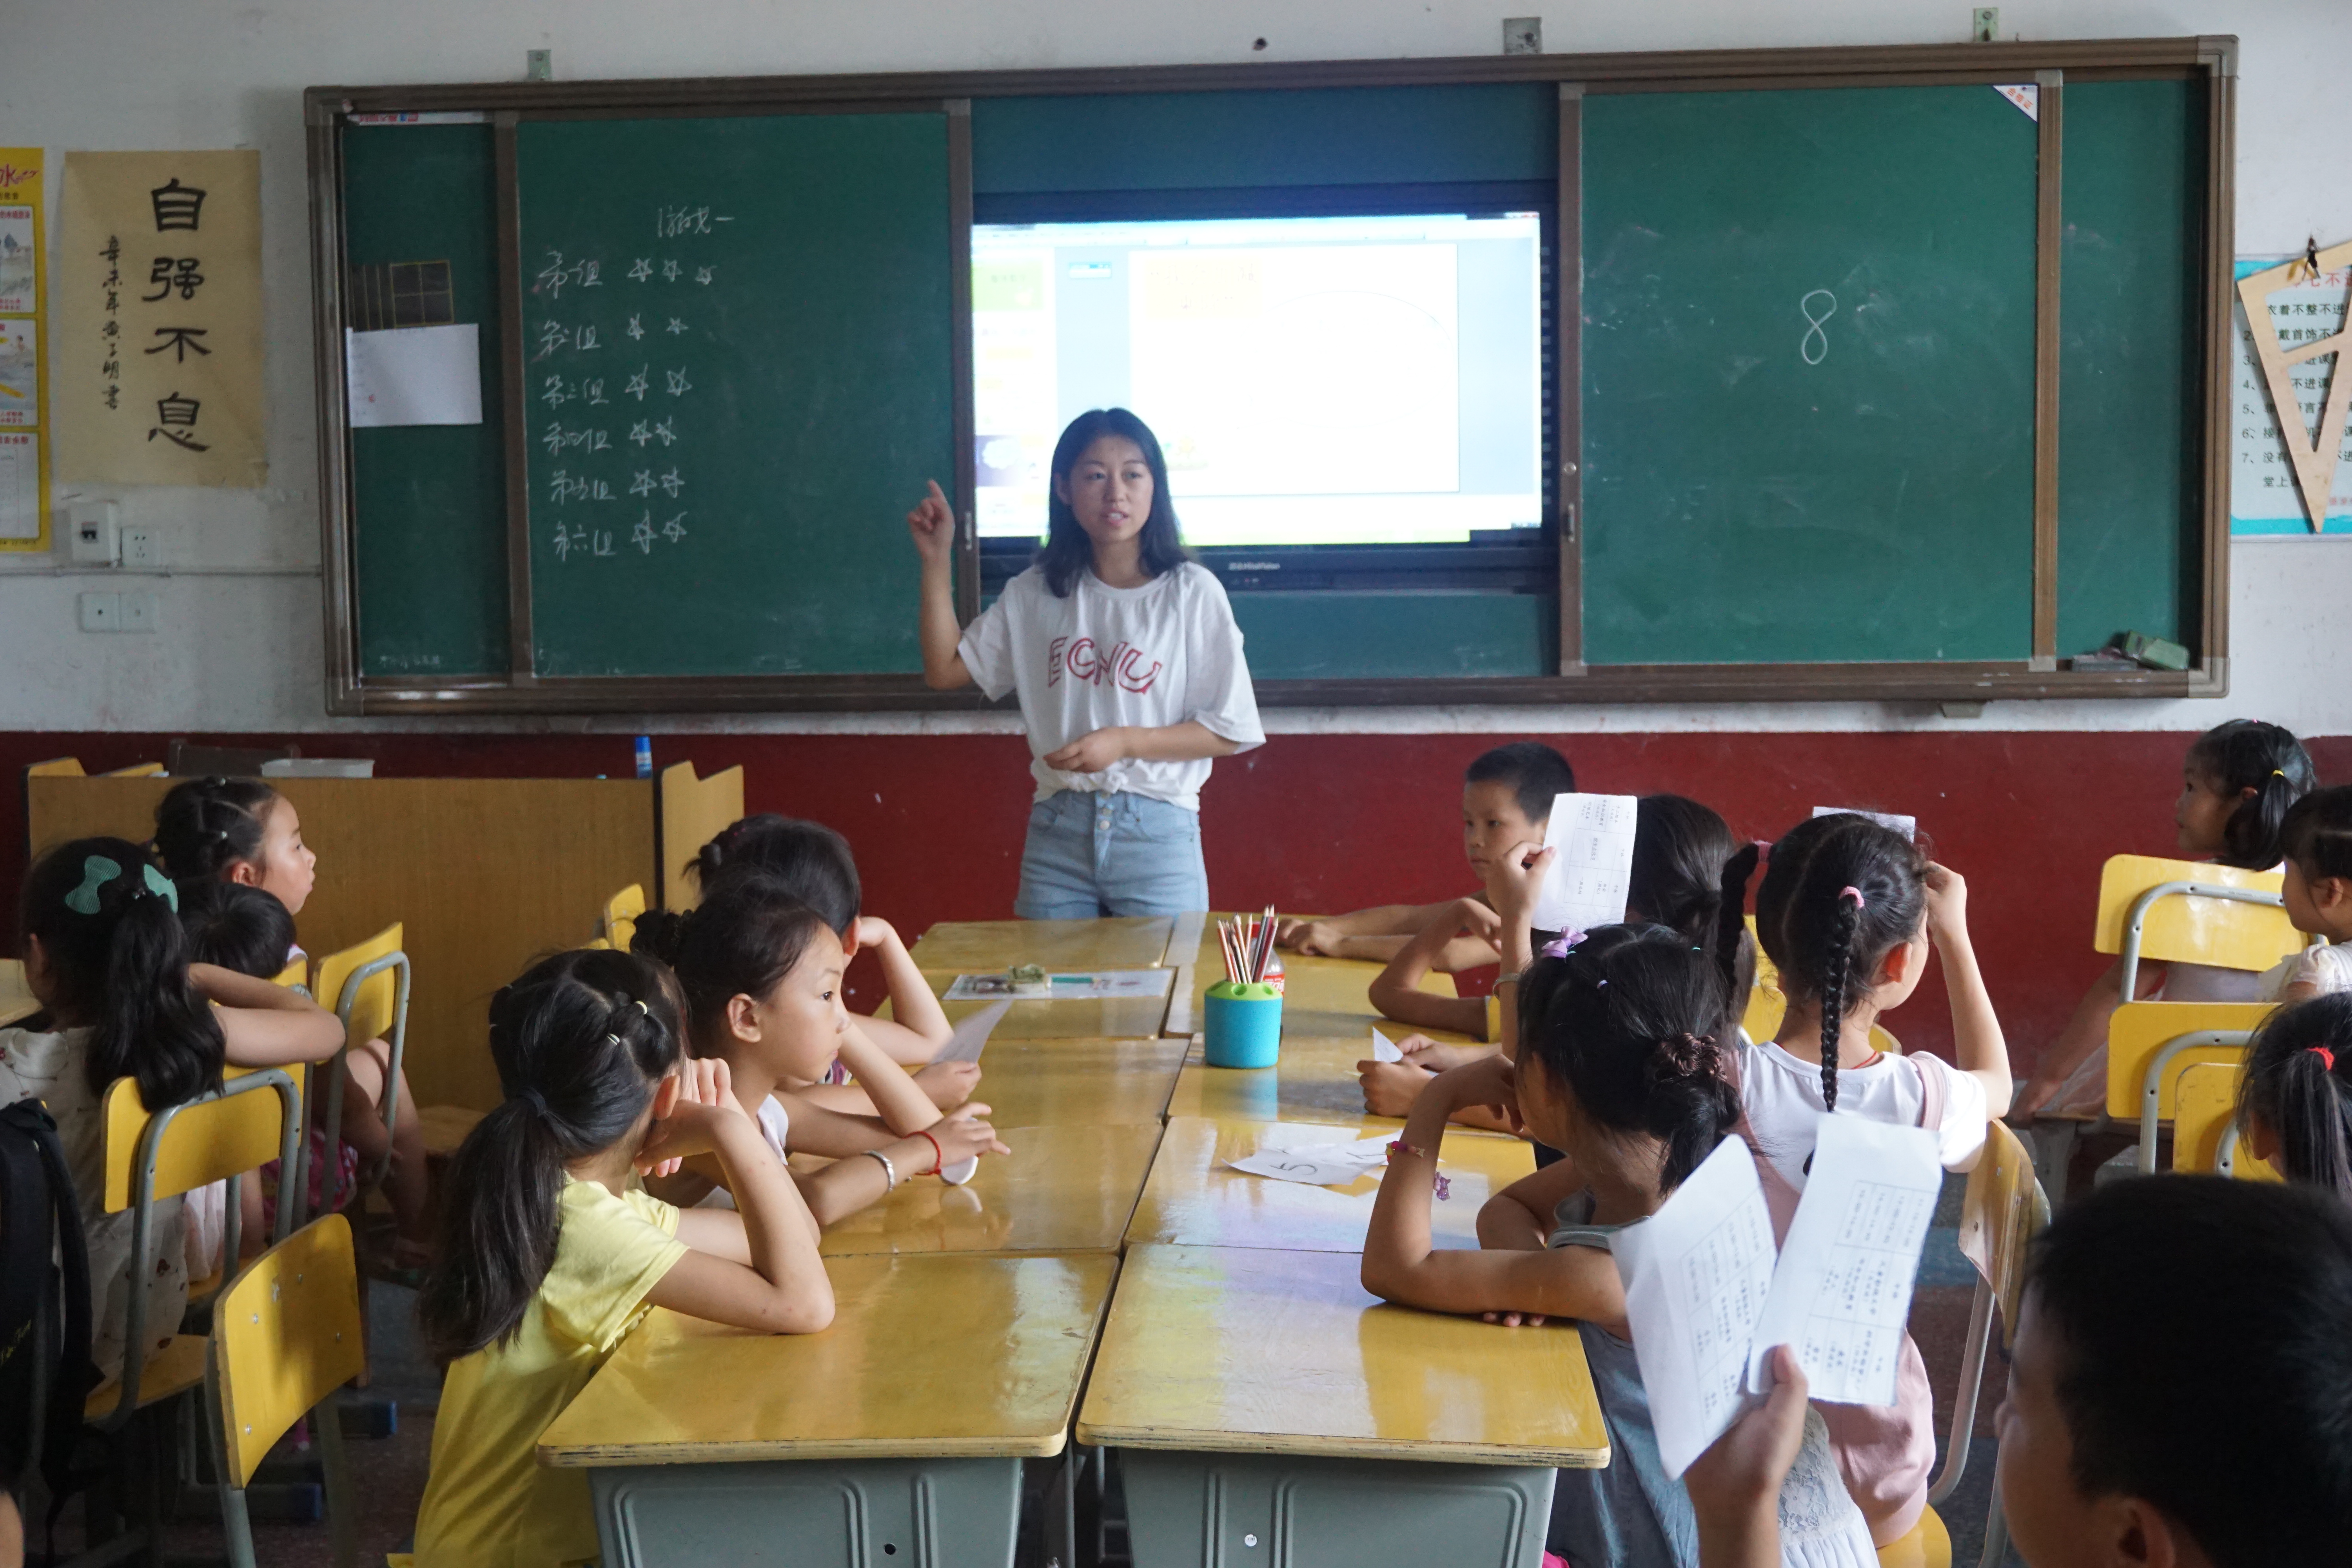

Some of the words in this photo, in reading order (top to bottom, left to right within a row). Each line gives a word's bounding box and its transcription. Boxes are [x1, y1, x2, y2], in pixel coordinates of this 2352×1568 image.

[539, 250, 603, 299] 第一组
[142, 178, 212, 452] 自强不息
[1800, 289, 1837, 365] 8
